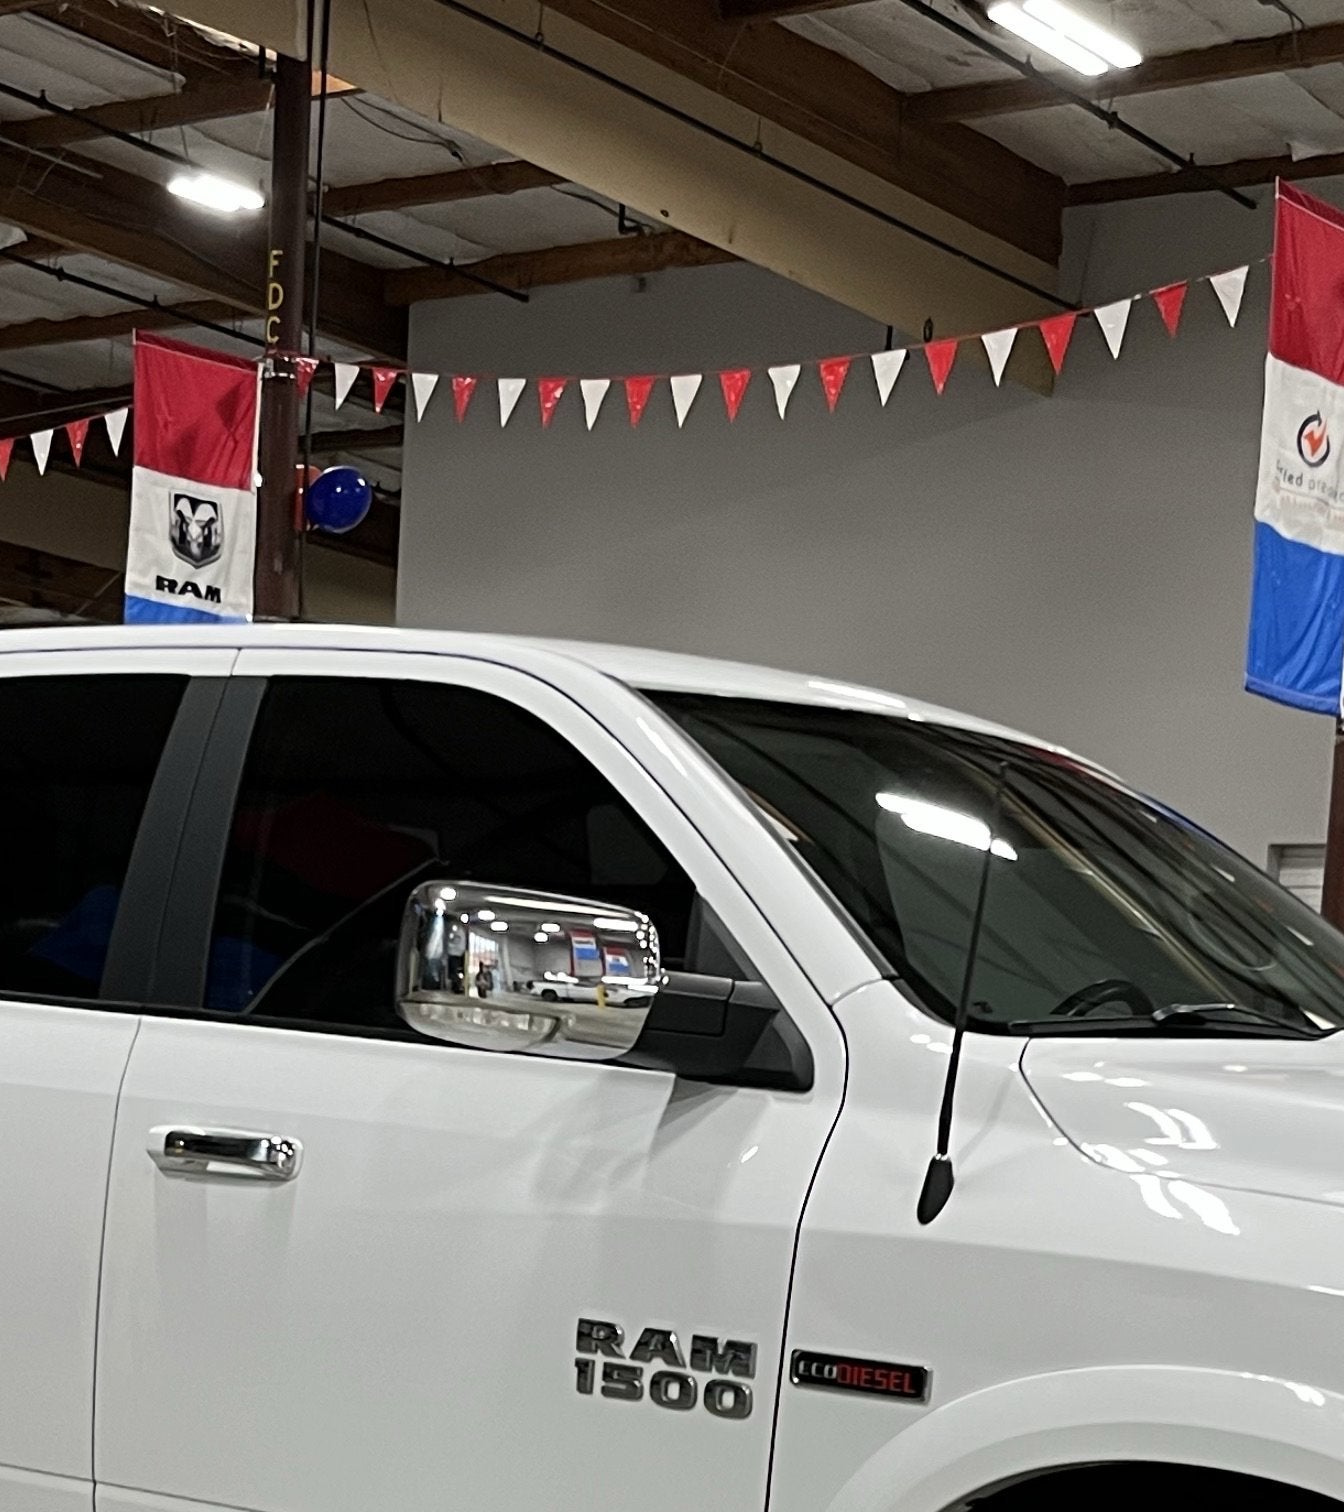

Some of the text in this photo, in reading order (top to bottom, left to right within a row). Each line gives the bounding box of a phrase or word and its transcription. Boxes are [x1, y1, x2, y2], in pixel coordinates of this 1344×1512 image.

[265, 249, 284, 344] FDC
[155, 575, 222, 603] RAM
[575, 1317, 759, 1379] RAM
[573, 1357, 755, 1420] 1500
